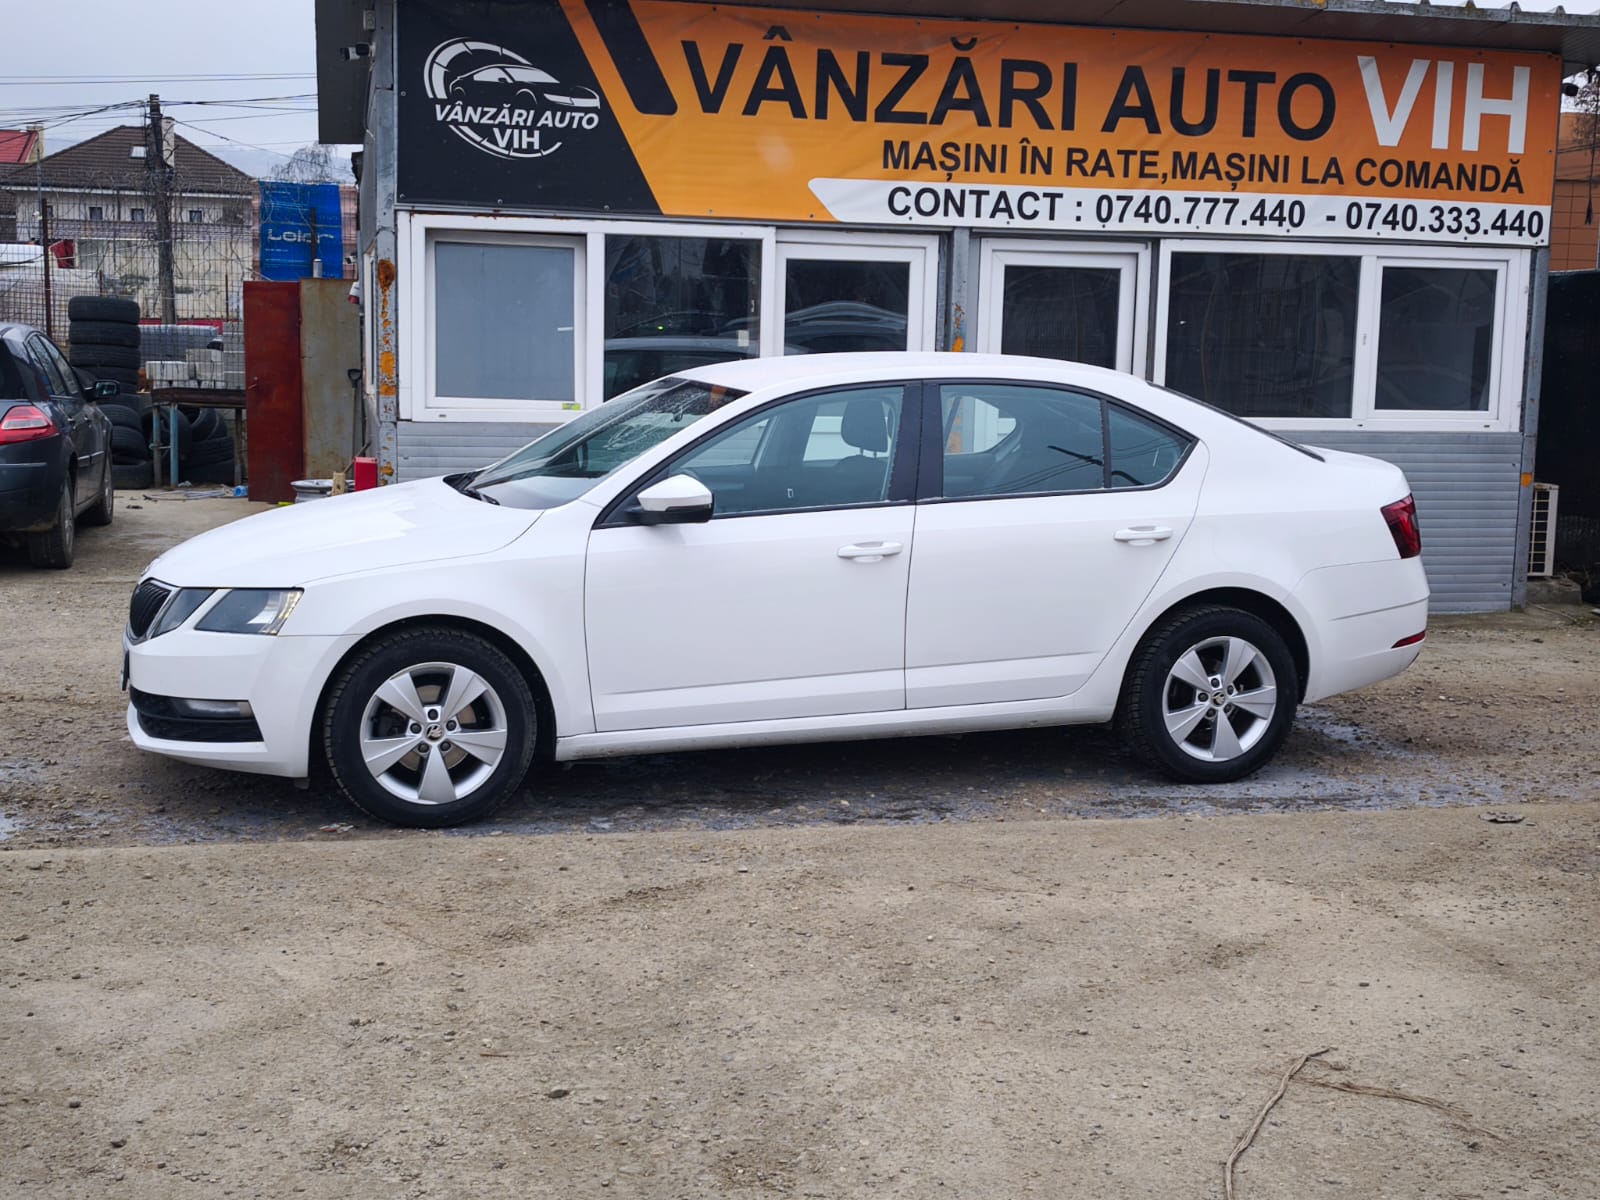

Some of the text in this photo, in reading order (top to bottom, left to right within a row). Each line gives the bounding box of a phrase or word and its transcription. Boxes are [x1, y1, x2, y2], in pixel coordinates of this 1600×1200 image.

[434, 100, 600, 131] VÂNZĂRI AUTO
[680, 25, 1532, 155] VÂNZĂRI AUTO VIH
[492, 127, 541, 151] VIH
[881, 139, 1008, 183] MAȘINI
[1018, 136, 1054, 176] ÎN
[1301, 155, 1345, 186] LA
[1354, 157, 1525, 195] COMANDĂ
[887, 187, 1064, 221] CONTACT
[1096, 194, 1306, 228] 0740.777.440
[1345, 201, 1545, 239] 0740.333.440
